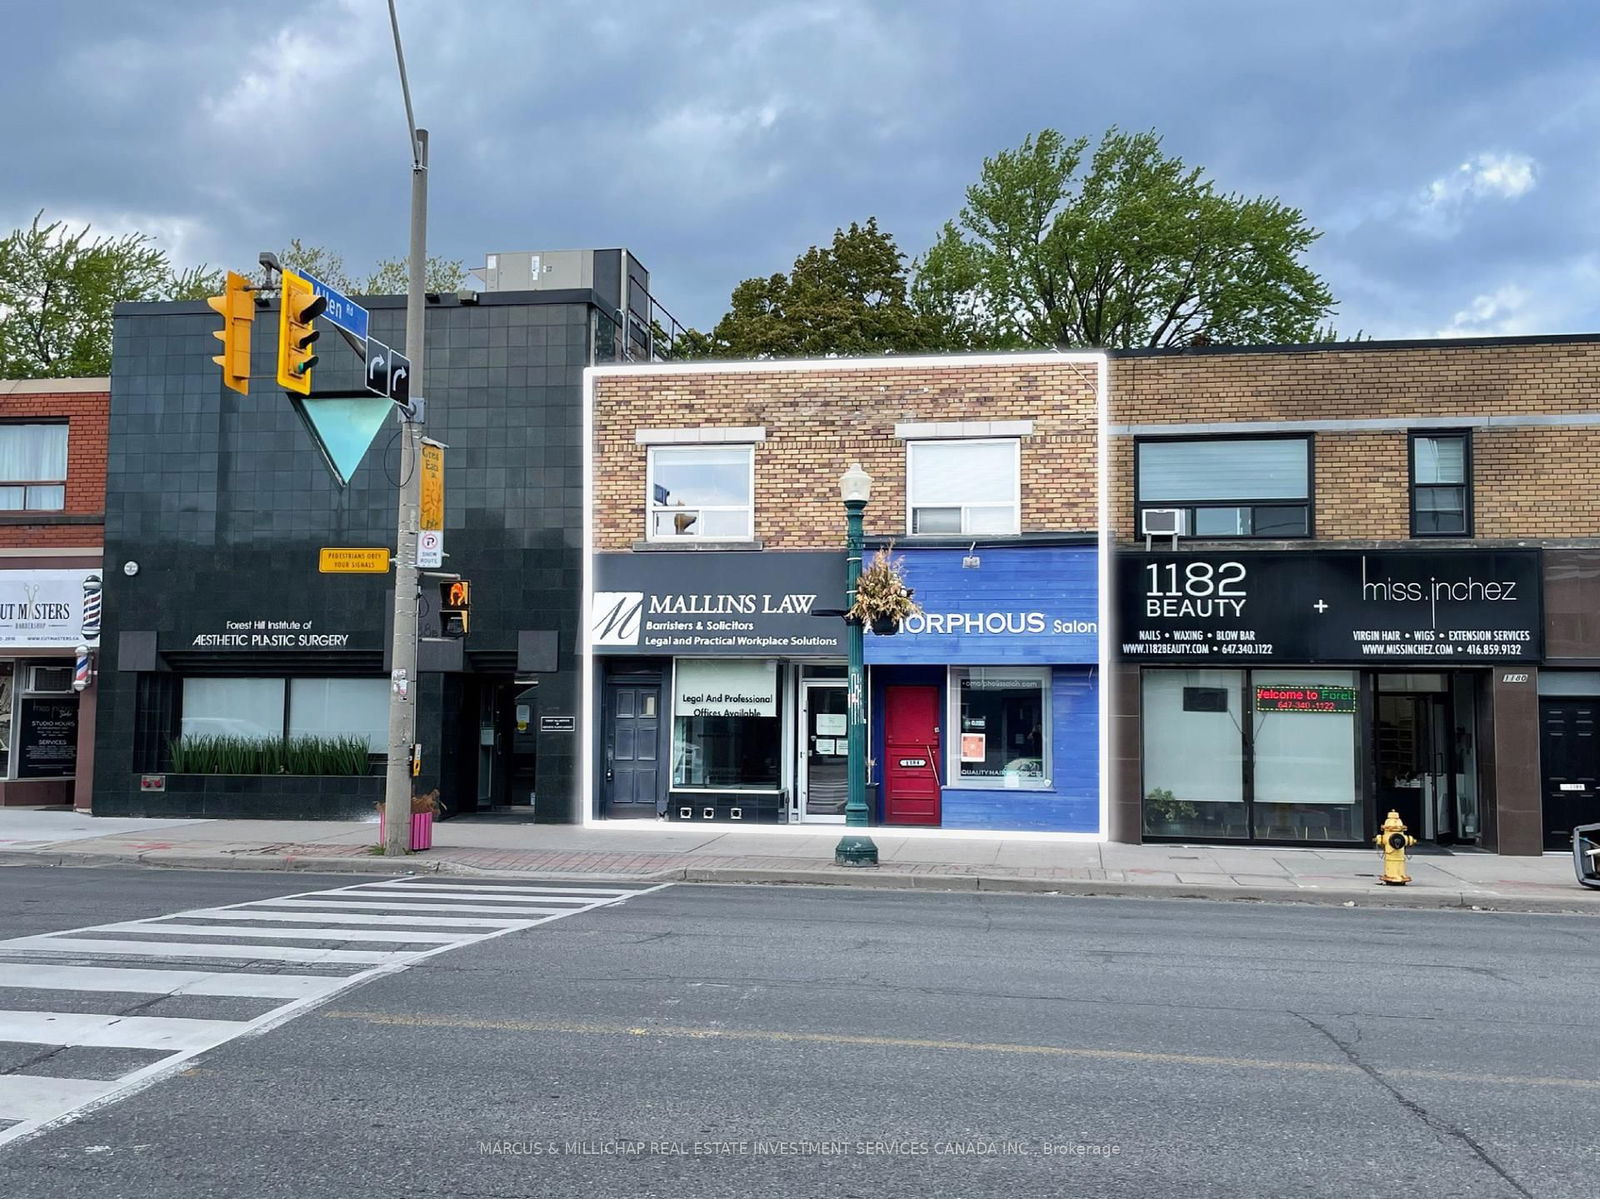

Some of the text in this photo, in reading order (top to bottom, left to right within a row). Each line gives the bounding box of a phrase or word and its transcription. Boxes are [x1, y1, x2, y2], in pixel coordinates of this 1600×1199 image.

[346, 304, 354, 317] Rd
[1146, 562, 1247, 596] 1182
[648, 594, 817, 614] MALLINS LAW
[1146, 599, 1246, 617] BEAUTY
[226, 620, 312, 630] Forest Hill Institute of
[646, 621, 754, 630] Barristers & Solicitors
[1053, 620, 1097, 634] Salon
[192, 634, 349, 646] AESTHETIC PLASTIC SURGERY
[1139, 630, 1256, 641] NAILS WAXING BLOW BAR
[1353, 630, 1530, 641] VIRGIN HAIR WIGS EXTENSION SERVICES
[645, 637, 837, 647] Legal and Practical Workplace Solutions
[1122, 644, 1272, 654] WWW.1182BEAUTY.COM 647.340.1122
[1362, 644, 1521, 655] WWW.MISSINCHEZ.COM 416.859.9132
[683, 694, 772, 704] Legal And Professional
[1306, 690, 1318, 700] to
[694, 709, 761, 717] Offices Available
